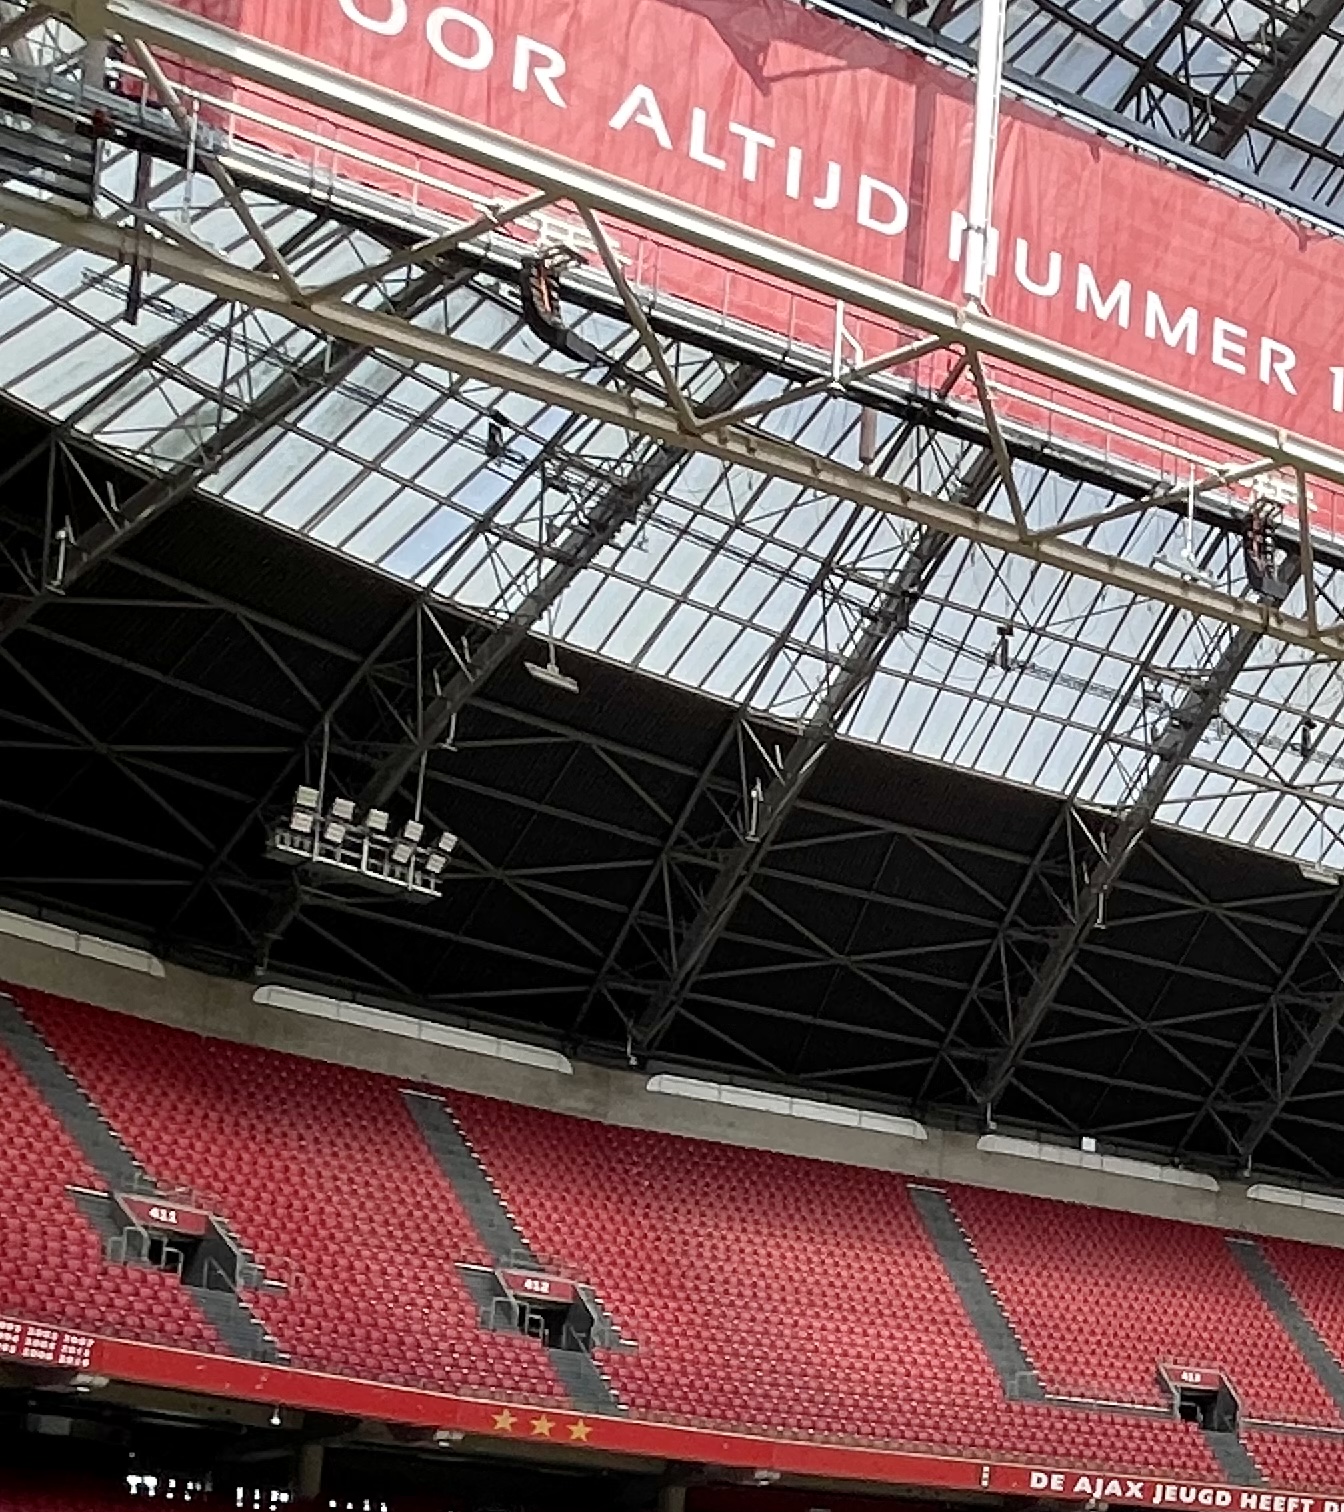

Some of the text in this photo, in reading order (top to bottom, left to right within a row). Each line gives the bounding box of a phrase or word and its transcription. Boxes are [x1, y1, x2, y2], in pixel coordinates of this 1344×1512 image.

[608, 84, 909, 236] ALTIJD
[149, 1207, 177, 1223] 411
[525, 1279, 549, 1293] 412
[1029, 1471, 1064, 1492] DE
[1074, 1475, 1144, 1501] AJAX
[1152, 1484, 1232, 1507] JEUGD
